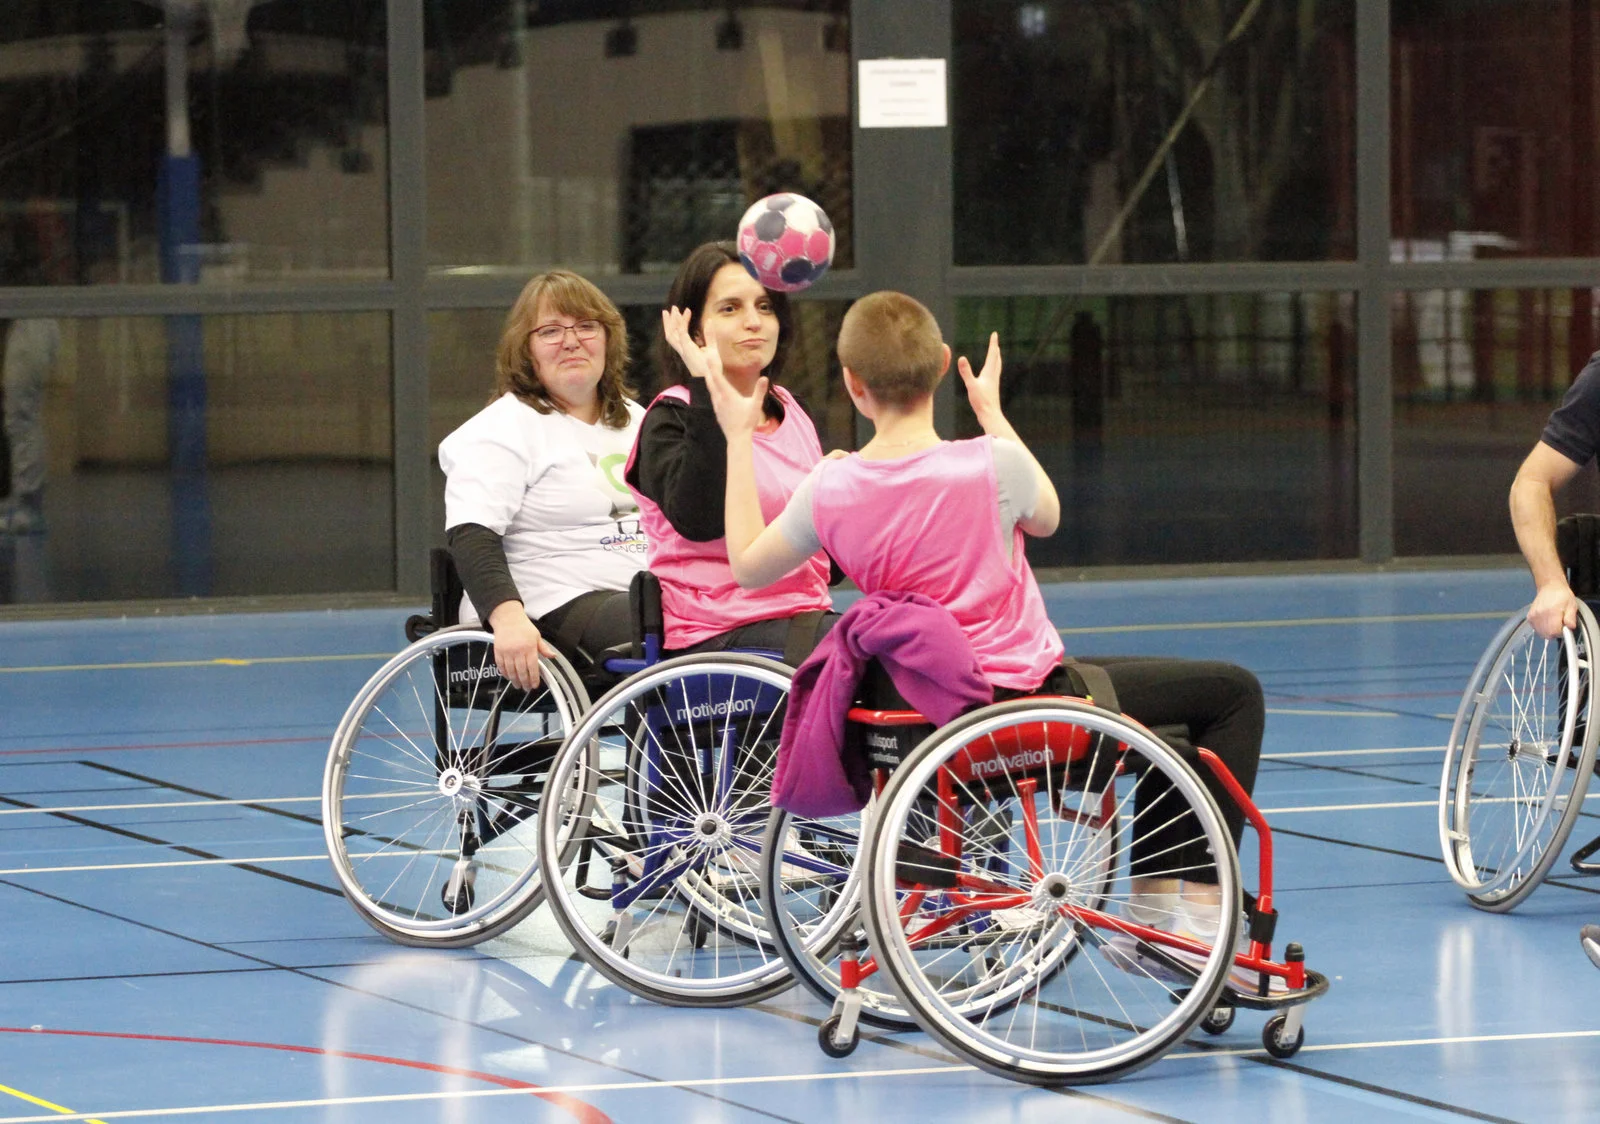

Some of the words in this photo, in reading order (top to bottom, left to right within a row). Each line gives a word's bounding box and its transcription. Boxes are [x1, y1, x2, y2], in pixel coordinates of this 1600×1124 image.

[603, 543, 648, 554] CONCEP
[450, 664, 503, 683] motivatio
[676, 698, 755, 721] motivation
[971, 748, 1055, 776] motivation
